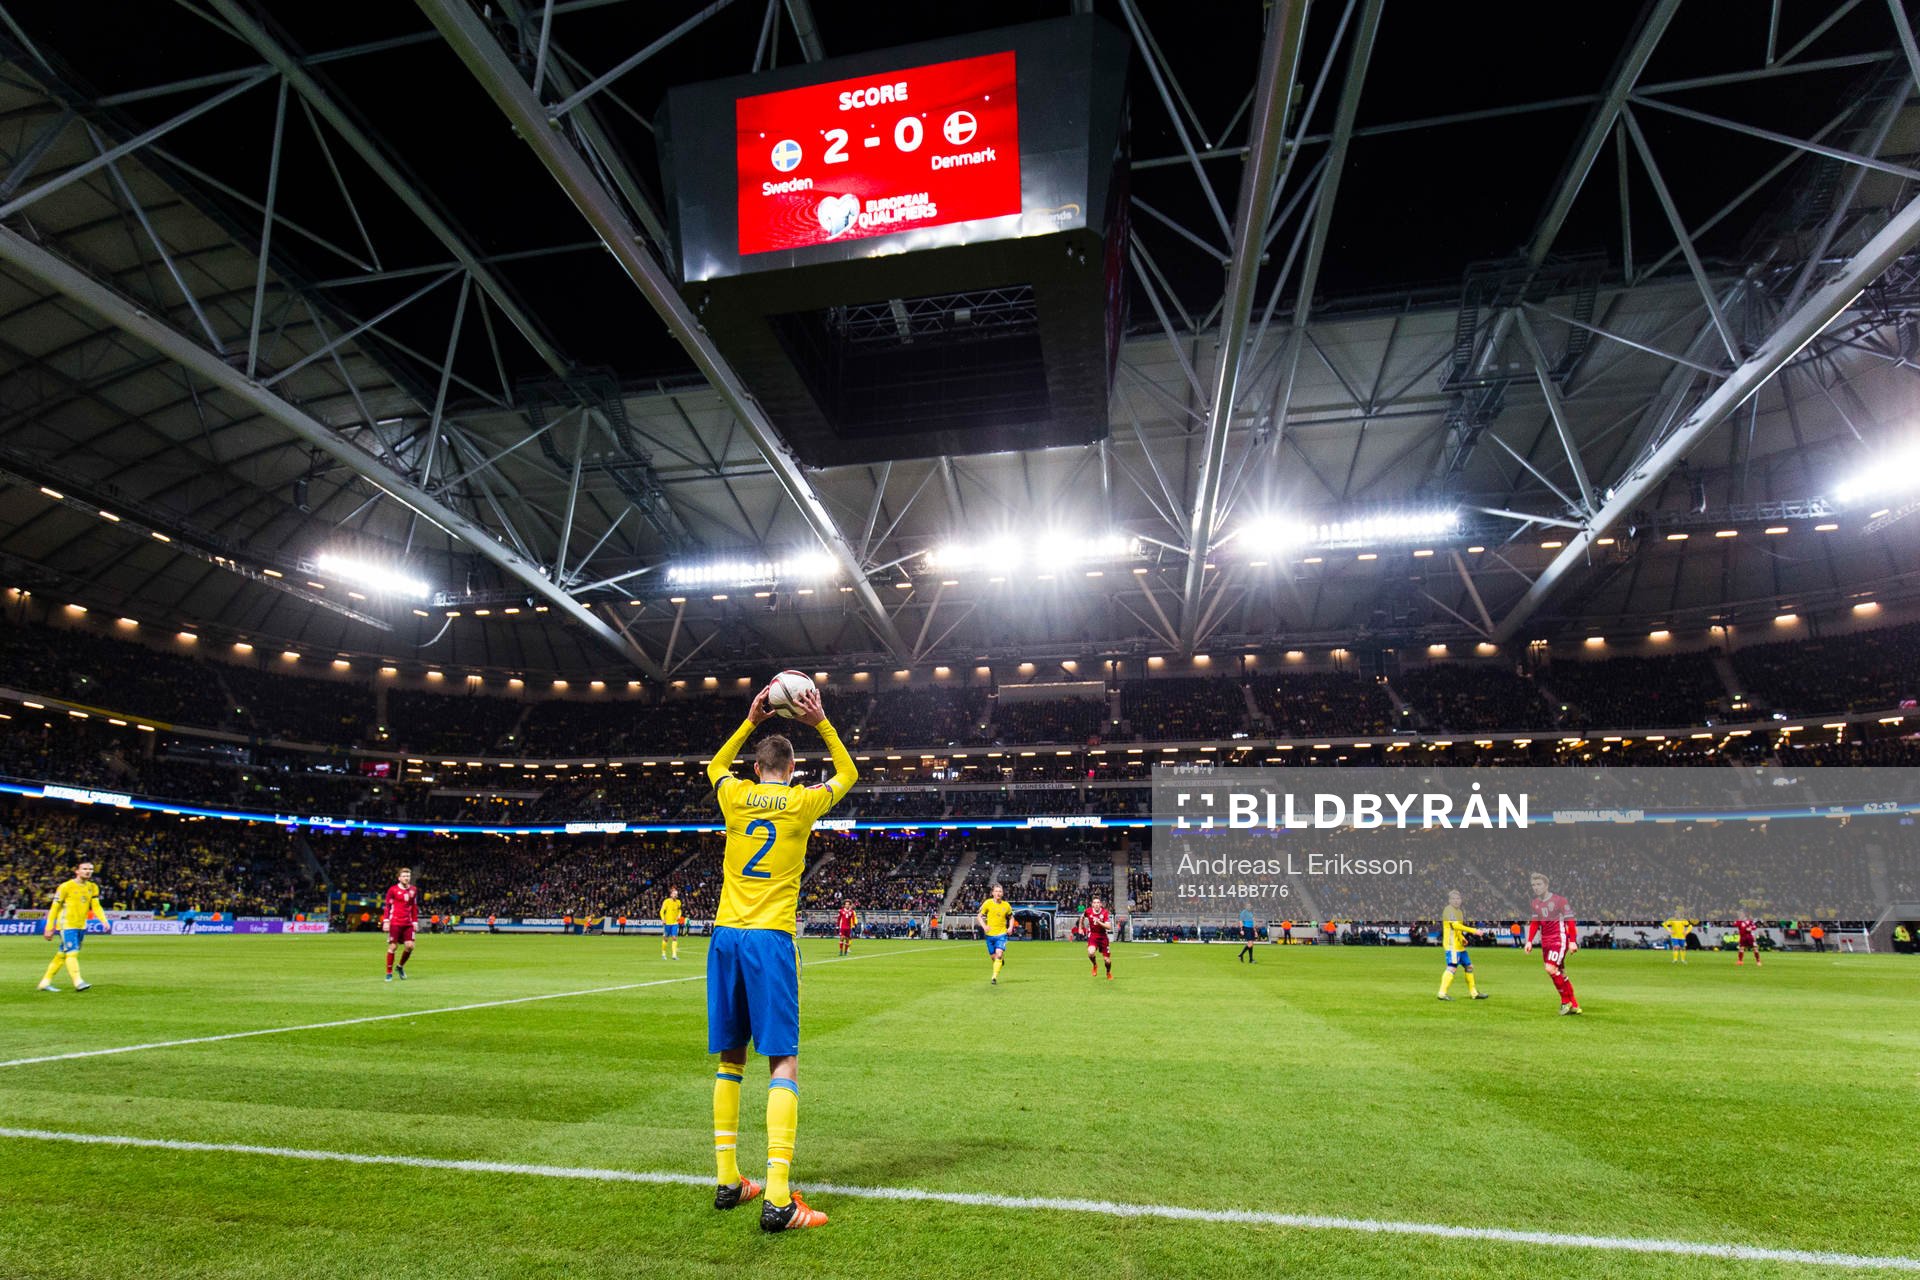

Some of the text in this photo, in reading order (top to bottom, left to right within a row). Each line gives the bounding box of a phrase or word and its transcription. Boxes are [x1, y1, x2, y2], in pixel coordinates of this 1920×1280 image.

[838, 82, 909, 111] SCORE
[823, 128, 849, 164] 2
[894, 116, 924, 153] 0
[931, 147, 996, 171] Denmark
[762, 177, 814, 196] Sweden
[865, 192, 929, 213] EUROPEAN
[858, 202, 938, 228] QUALIFIERS
[746, 792, 787, 810] LUSTIG
[1863, 802, 1898, 812] 62:32
[742, 819, 777, 878] 2
[114, 921, 174, 932] CAVALIERE
[1548, 950, 1558, 961] 10
